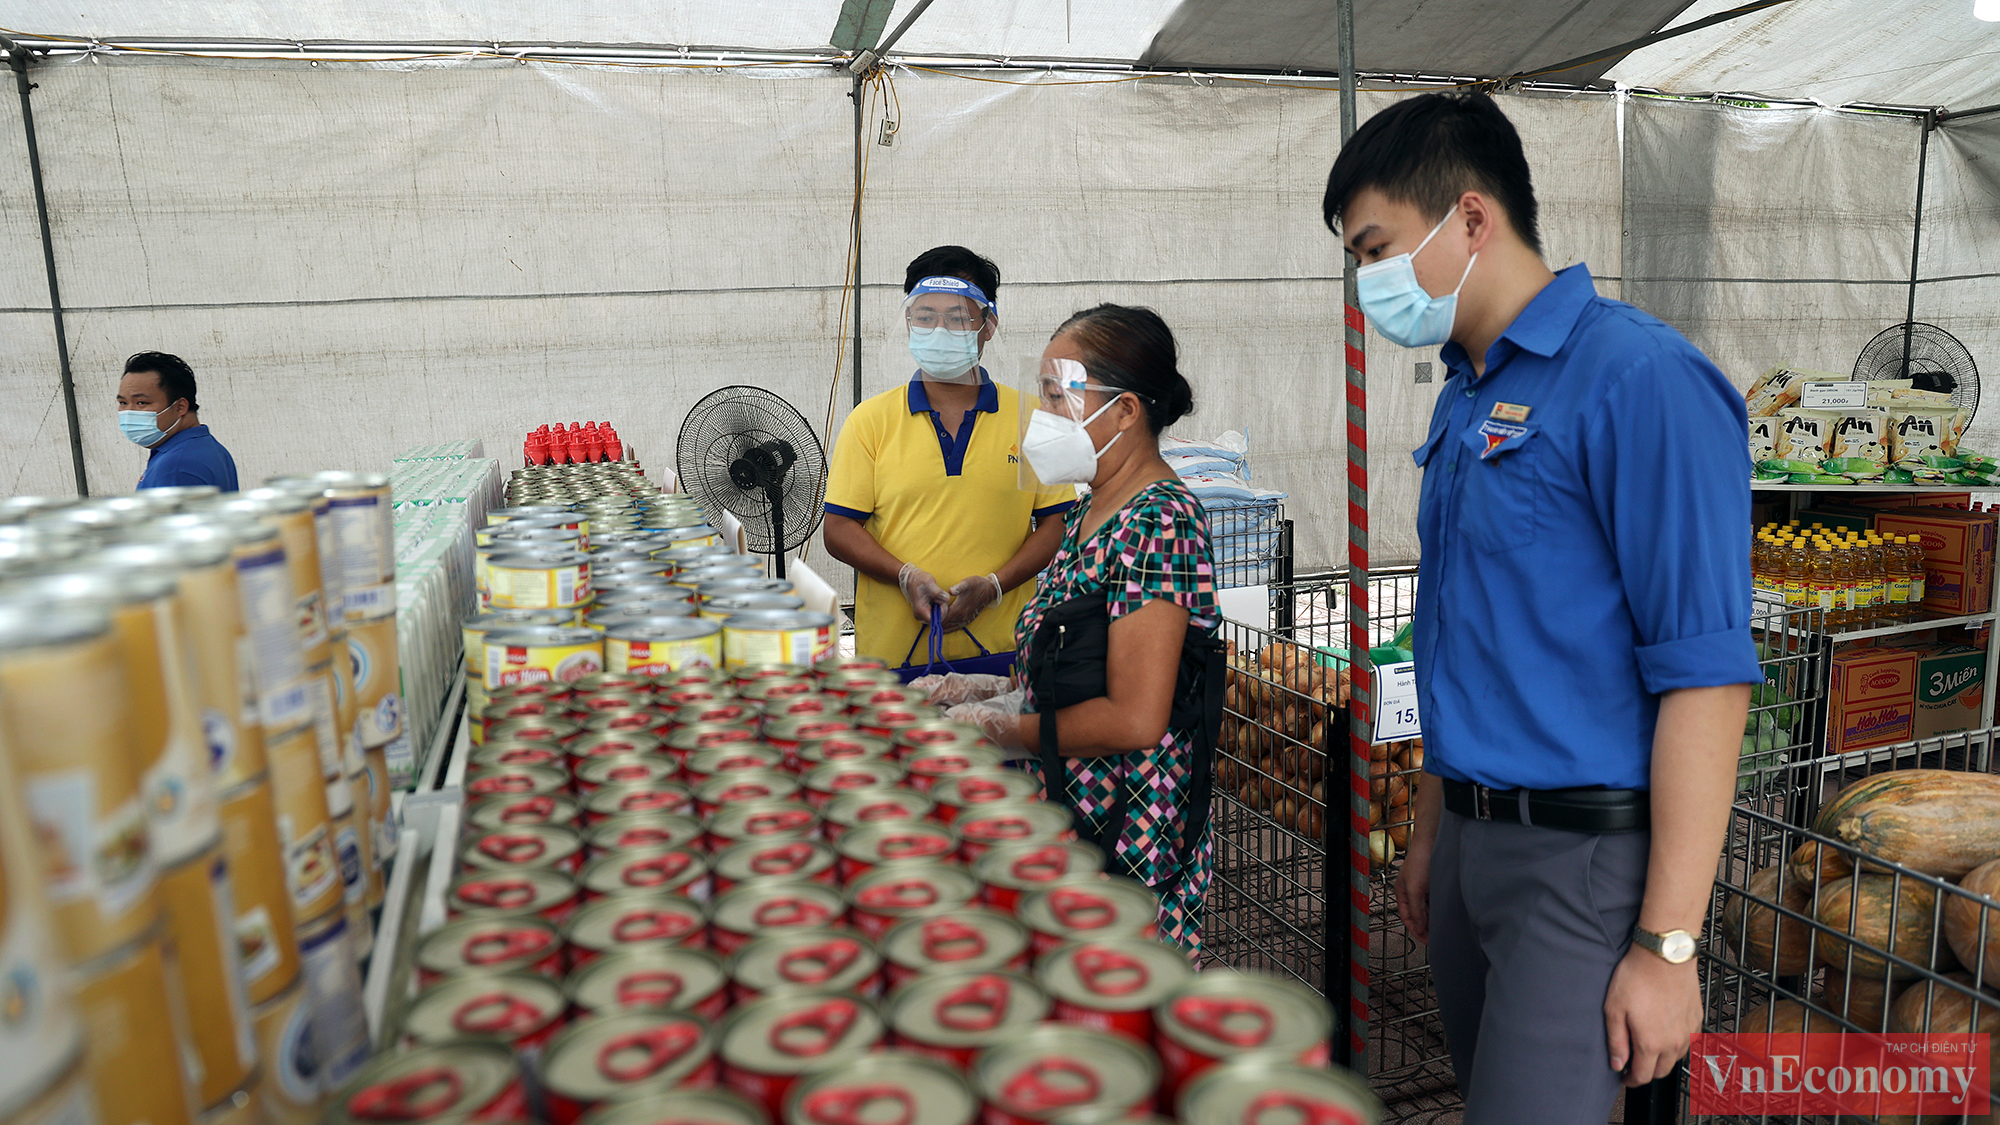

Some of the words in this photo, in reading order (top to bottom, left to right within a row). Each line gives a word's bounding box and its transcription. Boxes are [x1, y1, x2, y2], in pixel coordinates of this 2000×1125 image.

[942, 279, 960, 288] Shield
[1783, 416, 1818, 437] An
[1838, 417, 1874, 436] An
[1897, 415, 1934, 436] An
[1869, 670, 1880, 678] Cook
[1856, 712, 1877, 732] Hảo
[1878, 704, 1898, 724] Hảo
